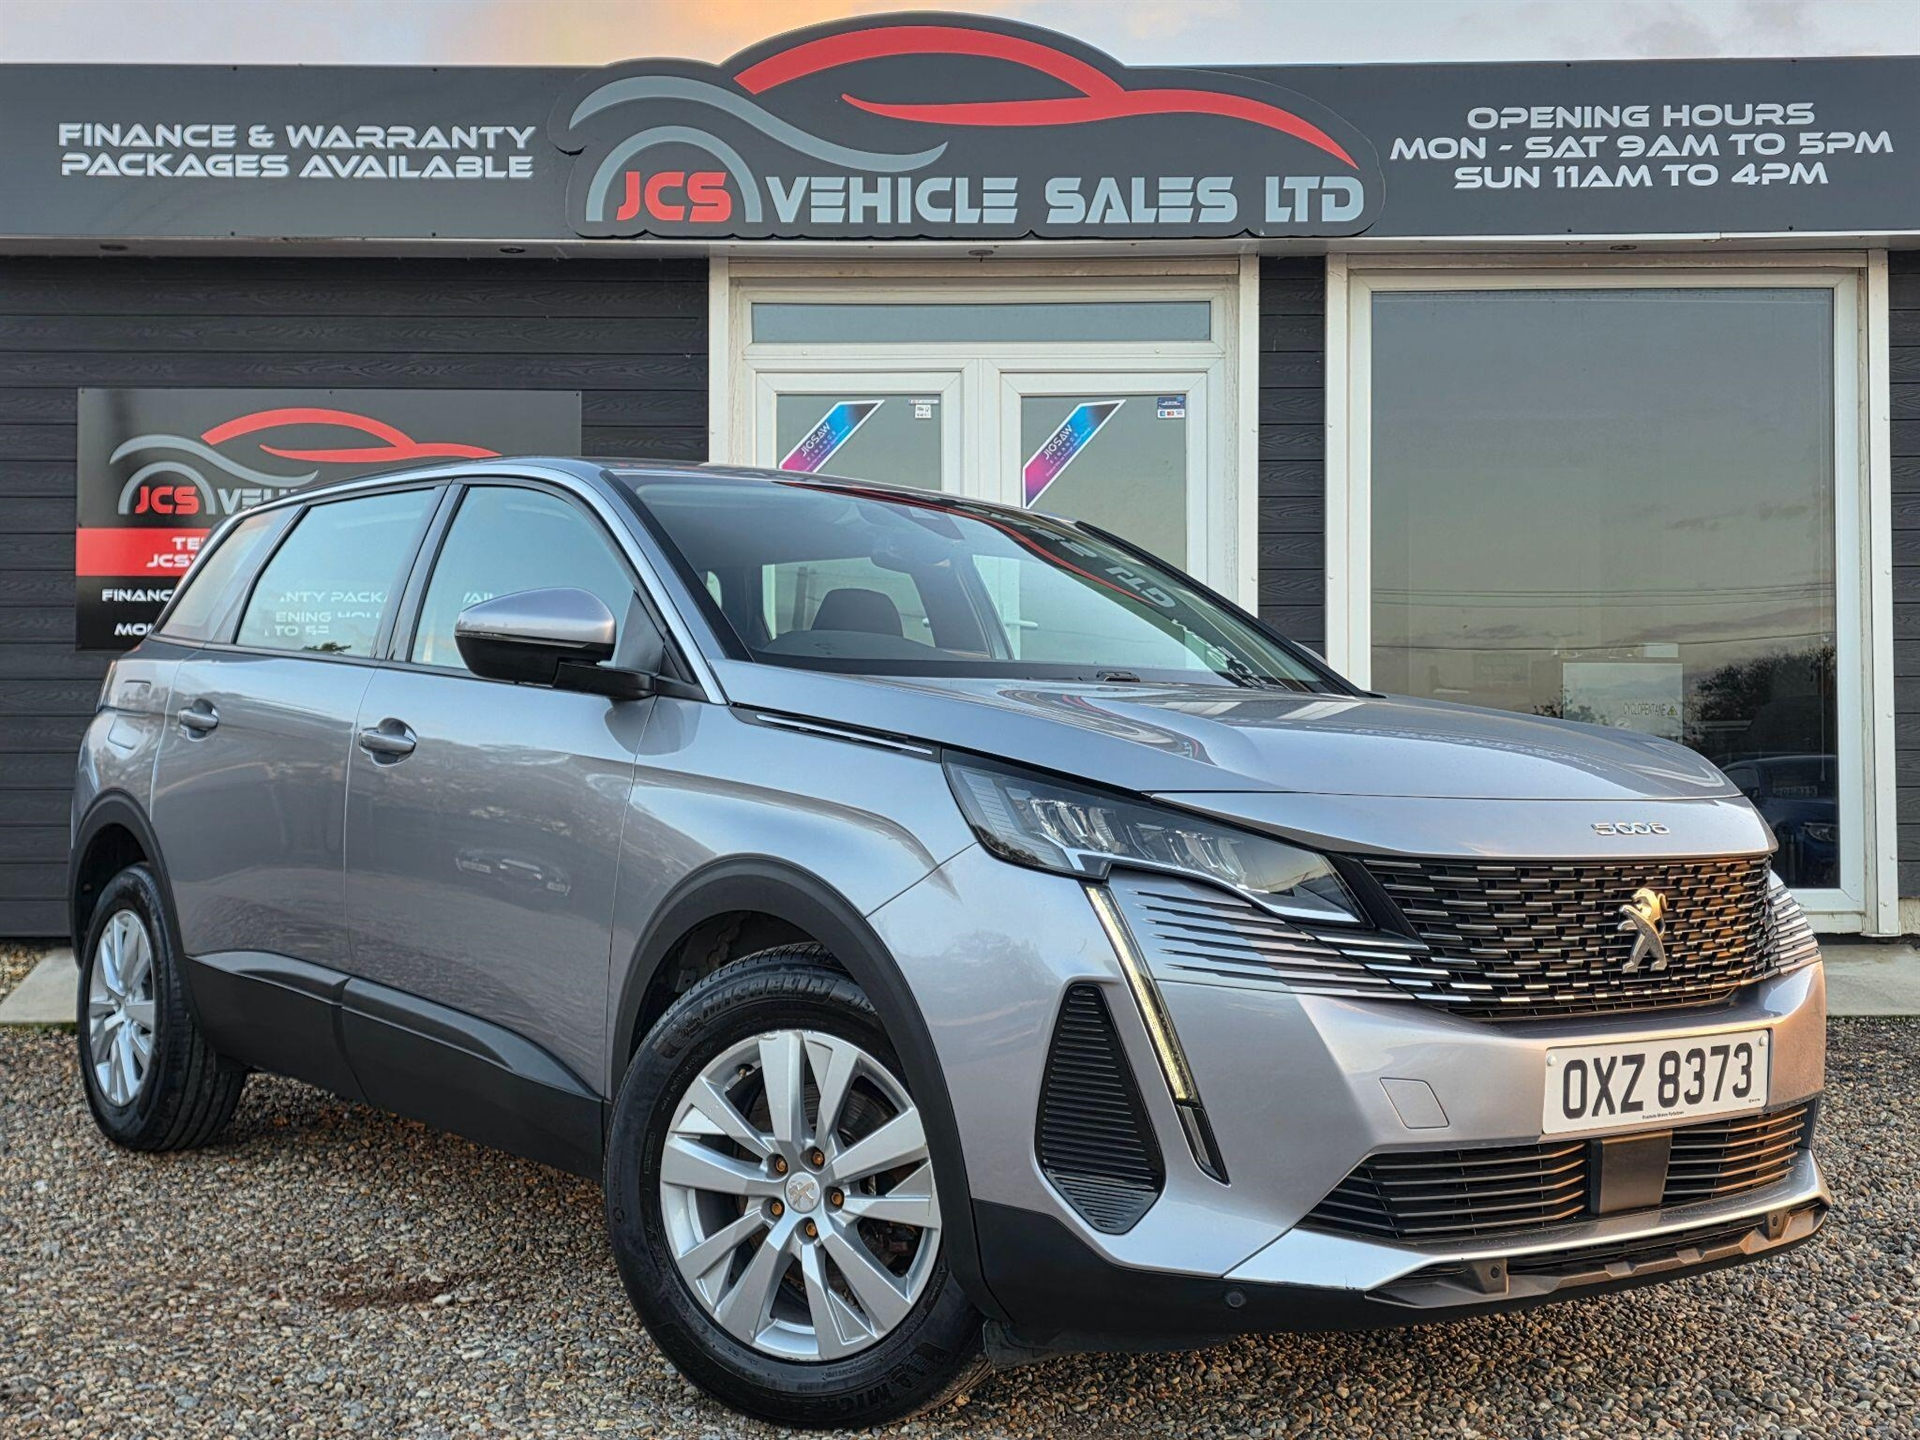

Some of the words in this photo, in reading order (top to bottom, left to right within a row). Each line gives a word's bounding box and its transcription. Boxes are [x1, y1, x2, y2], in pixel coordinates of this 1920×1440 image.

[1467, 105, 1651, 129] OPENING
[1662, 103, 1815, 127] HOURS
[58, 122, 236, 147] FINANCE
[247, 124, 274, 147] &
[285, 124, 536, 149] WARRANTY
[1390, 136, 1487, 160] MON
[1524, 134, 1608, 159] SAT
[1617, 133, 1720, 158] 9AM
[1728, 132, 1786, 156] TO
[1799, 130, 1895, 154] 5PM
[61, 152, 289, 177] PACKAGES
[298, 155, 534, 178] AVAILABLE
[1453, 165, 1540, 189] SUN
[1552, 163, 1654, 188] 11AM
[1661, 162, 1719, 186] TO
[1731, 161, 1829, 185] 4PM
[616, 171, 732, 223] JCS
[765, 175, 1020, 224] VEHICLE
[1044, 175, 1236, 224] SALES
[1264, 174, 1365, 223] LTD
[800, 421, 832, 457] JIGSAW
[1043, 424, 1074, 461] JIGSAW
[135, 486, 199, 515] JCS
[101, 588, 174, 602] FINANC
[1563, 1053, 1646, 1119] OXZ
[1658, 1042, 1753, 1109] 8373
